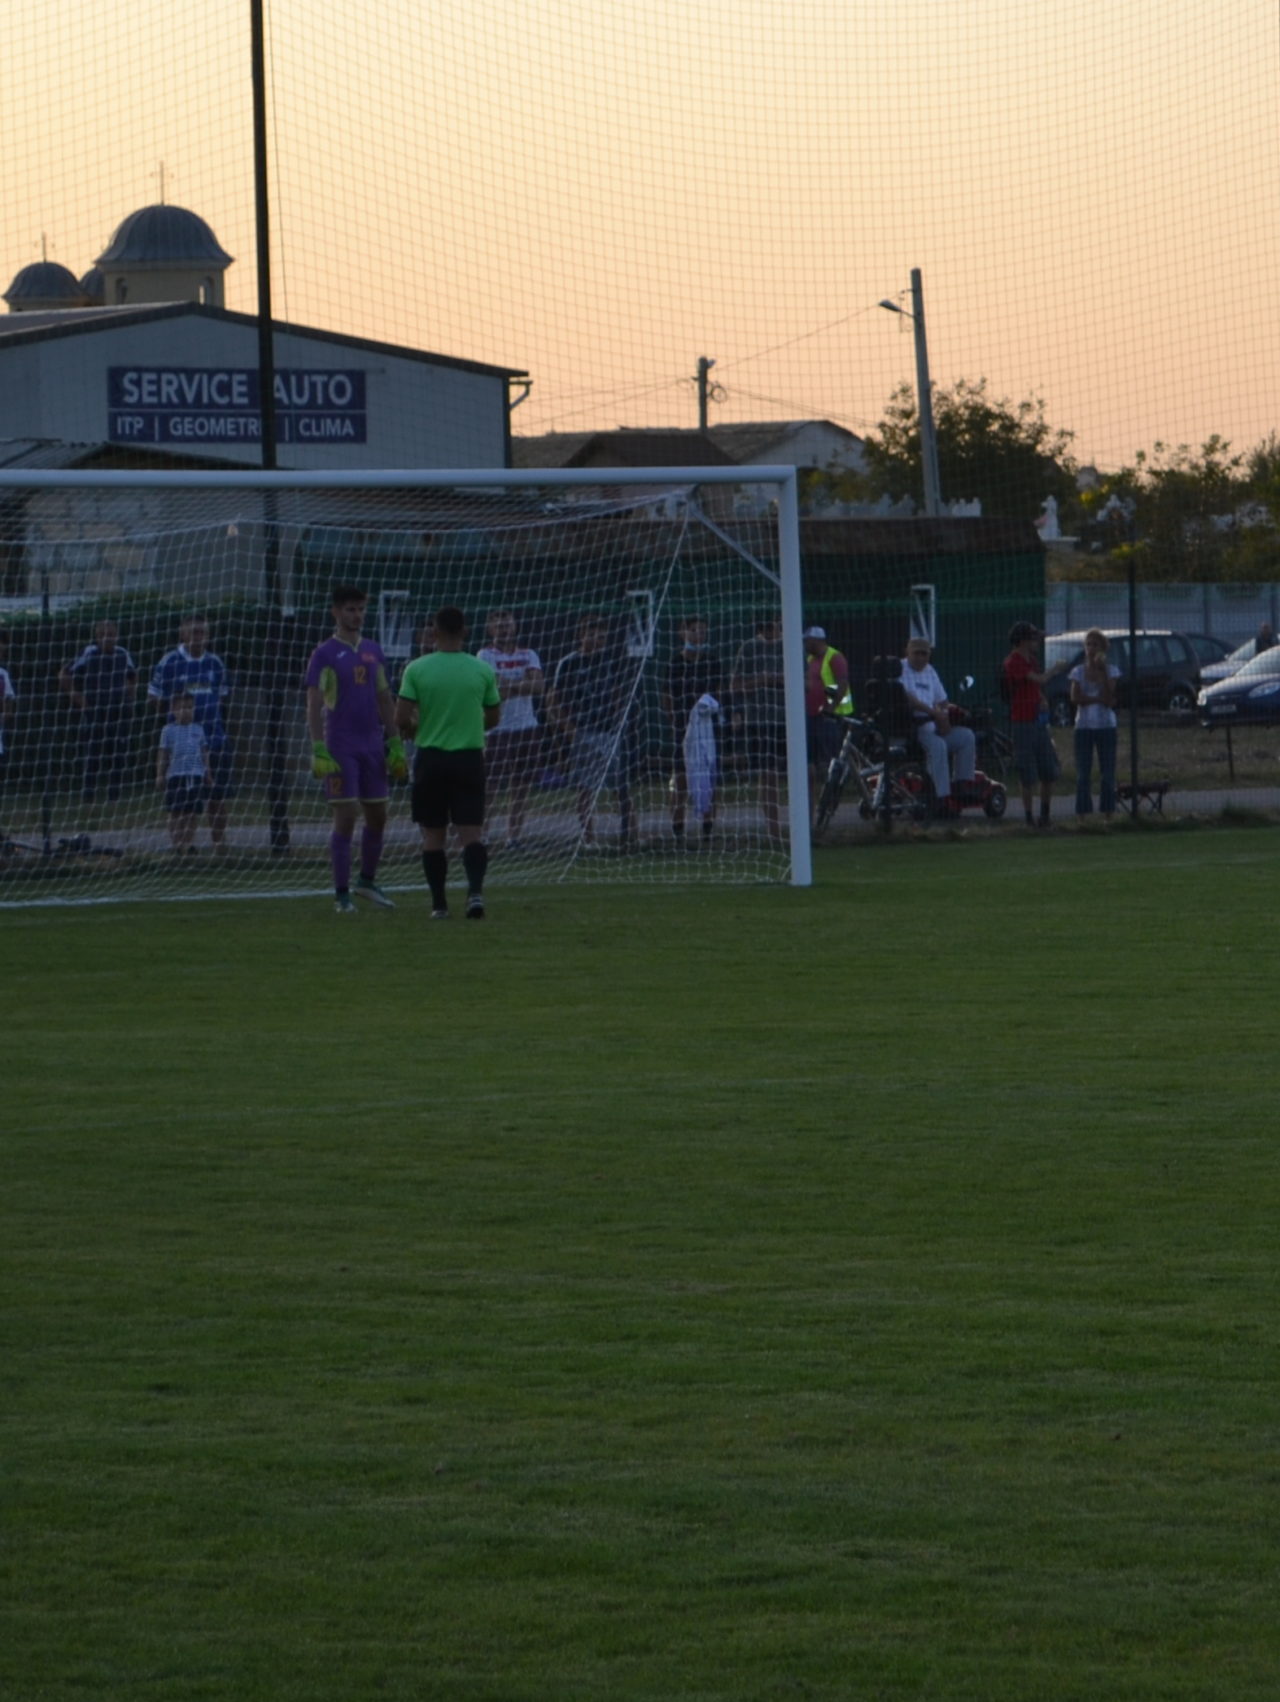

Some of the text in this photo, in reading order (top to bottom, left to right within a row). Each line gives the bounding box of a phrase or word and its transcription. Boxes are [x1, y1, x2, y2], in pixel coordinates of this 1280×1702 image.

[123, 371, 353, 405] SERVICE AUTO
[117, 416, 144, 435] ITP
[299, 418, 355, 436] CLIMA
[353, 664, 367, 685] 12
